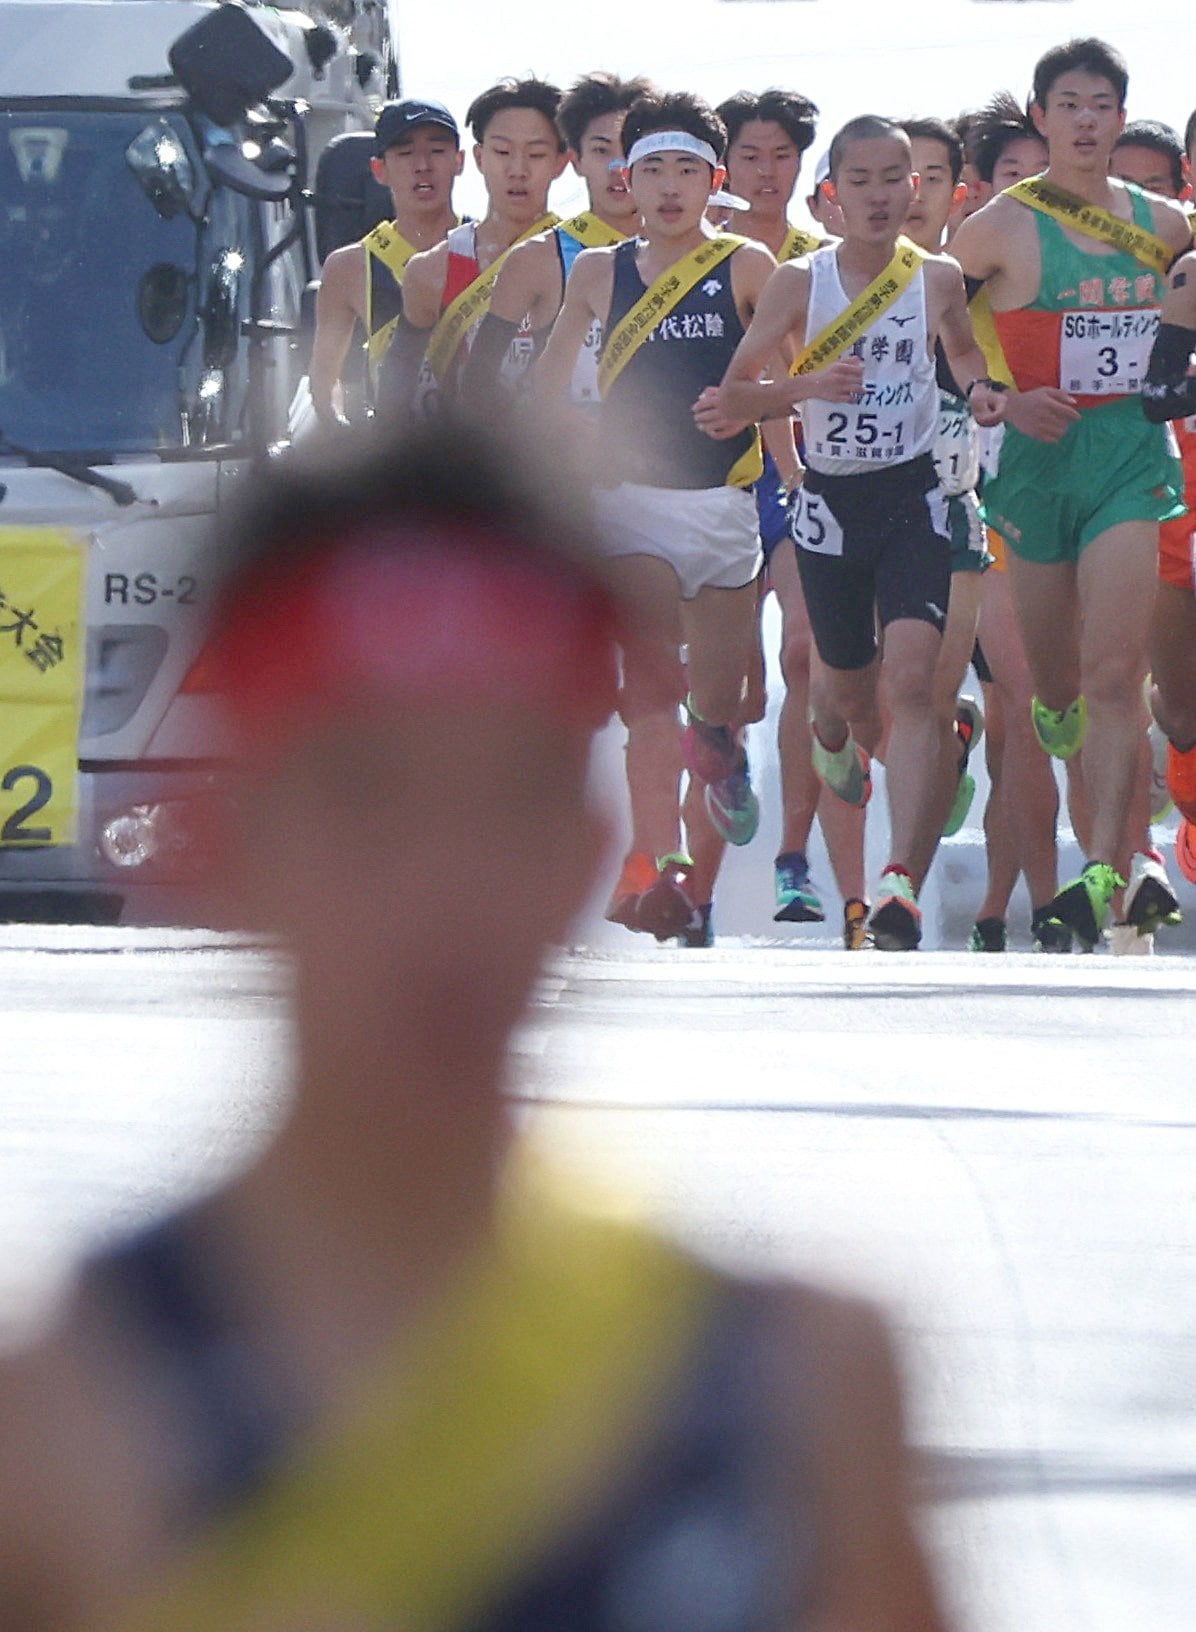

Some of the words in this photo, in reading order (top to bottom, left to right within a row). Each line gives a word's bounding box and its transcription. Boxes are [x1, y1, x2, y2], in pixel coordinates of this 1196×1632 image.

[826, 412, 904, 444] 25-1
[104, 572, 197, 605] RS-2
[0, 591, 64, 673] 大会
